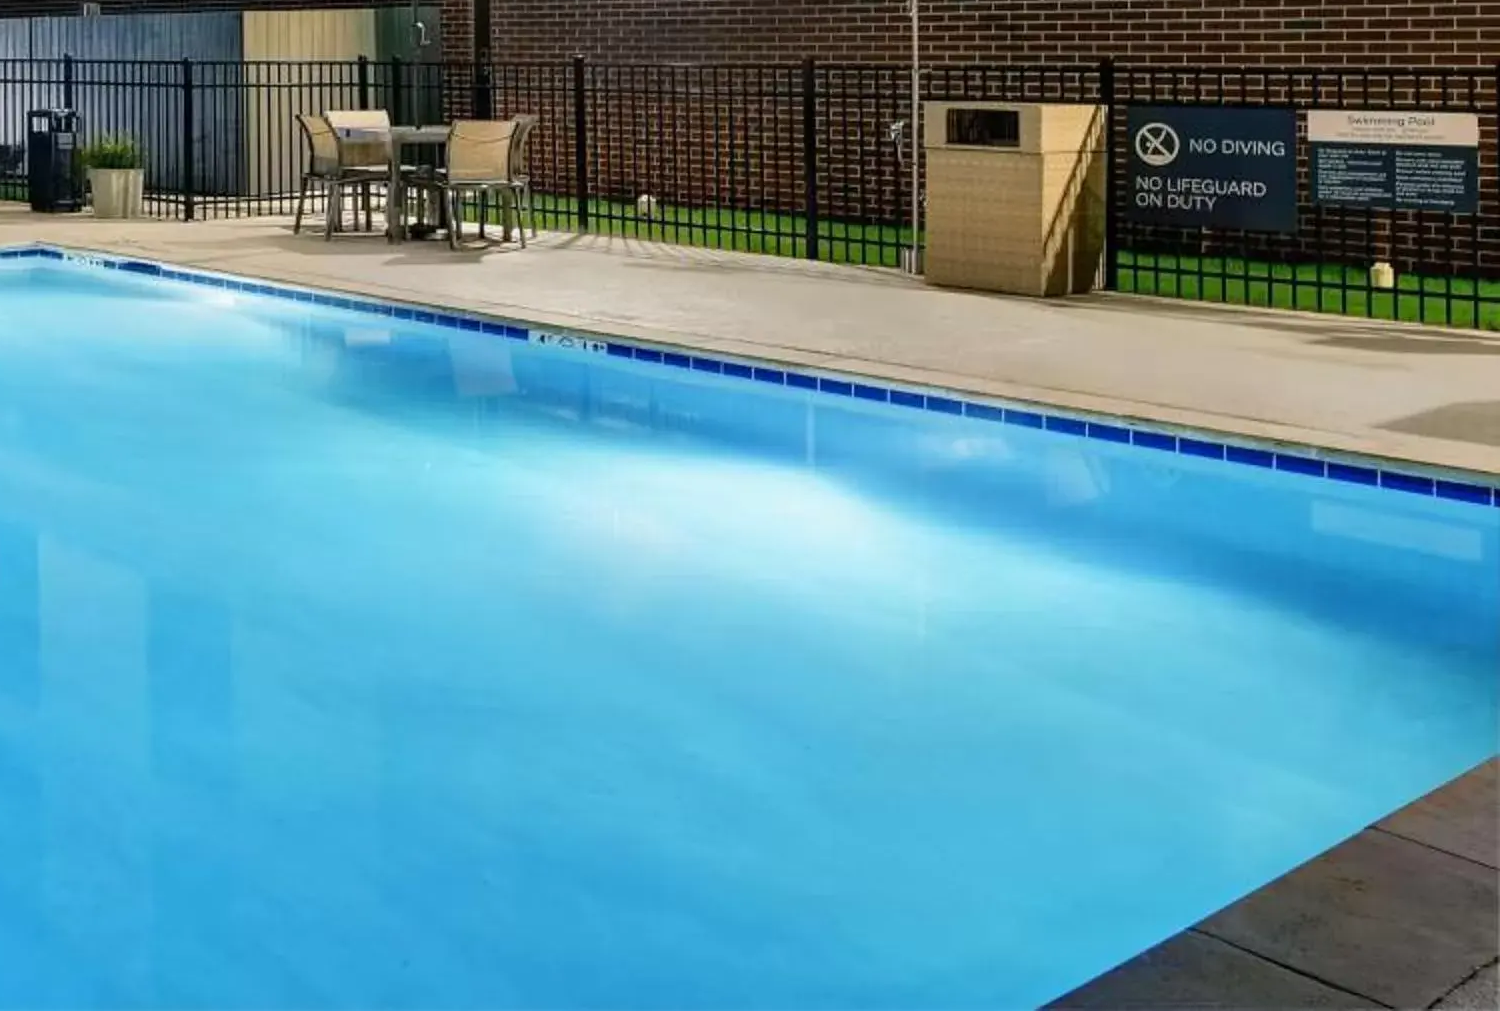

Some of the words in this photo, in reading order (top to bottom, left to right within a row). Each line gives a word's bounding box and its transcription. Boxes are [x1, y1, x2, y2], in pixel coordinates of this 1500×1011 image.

[1189, 138, 1217, 155] NO
[1221, 139, 1286, 157] DIVING
[1135, 176, 1162, 192] NO
[1167, 177, 1267, 199] LIFEGUARD
[1135, 192, 1162, 208] ON
[1167, 194, 1217, 211] DUTY
